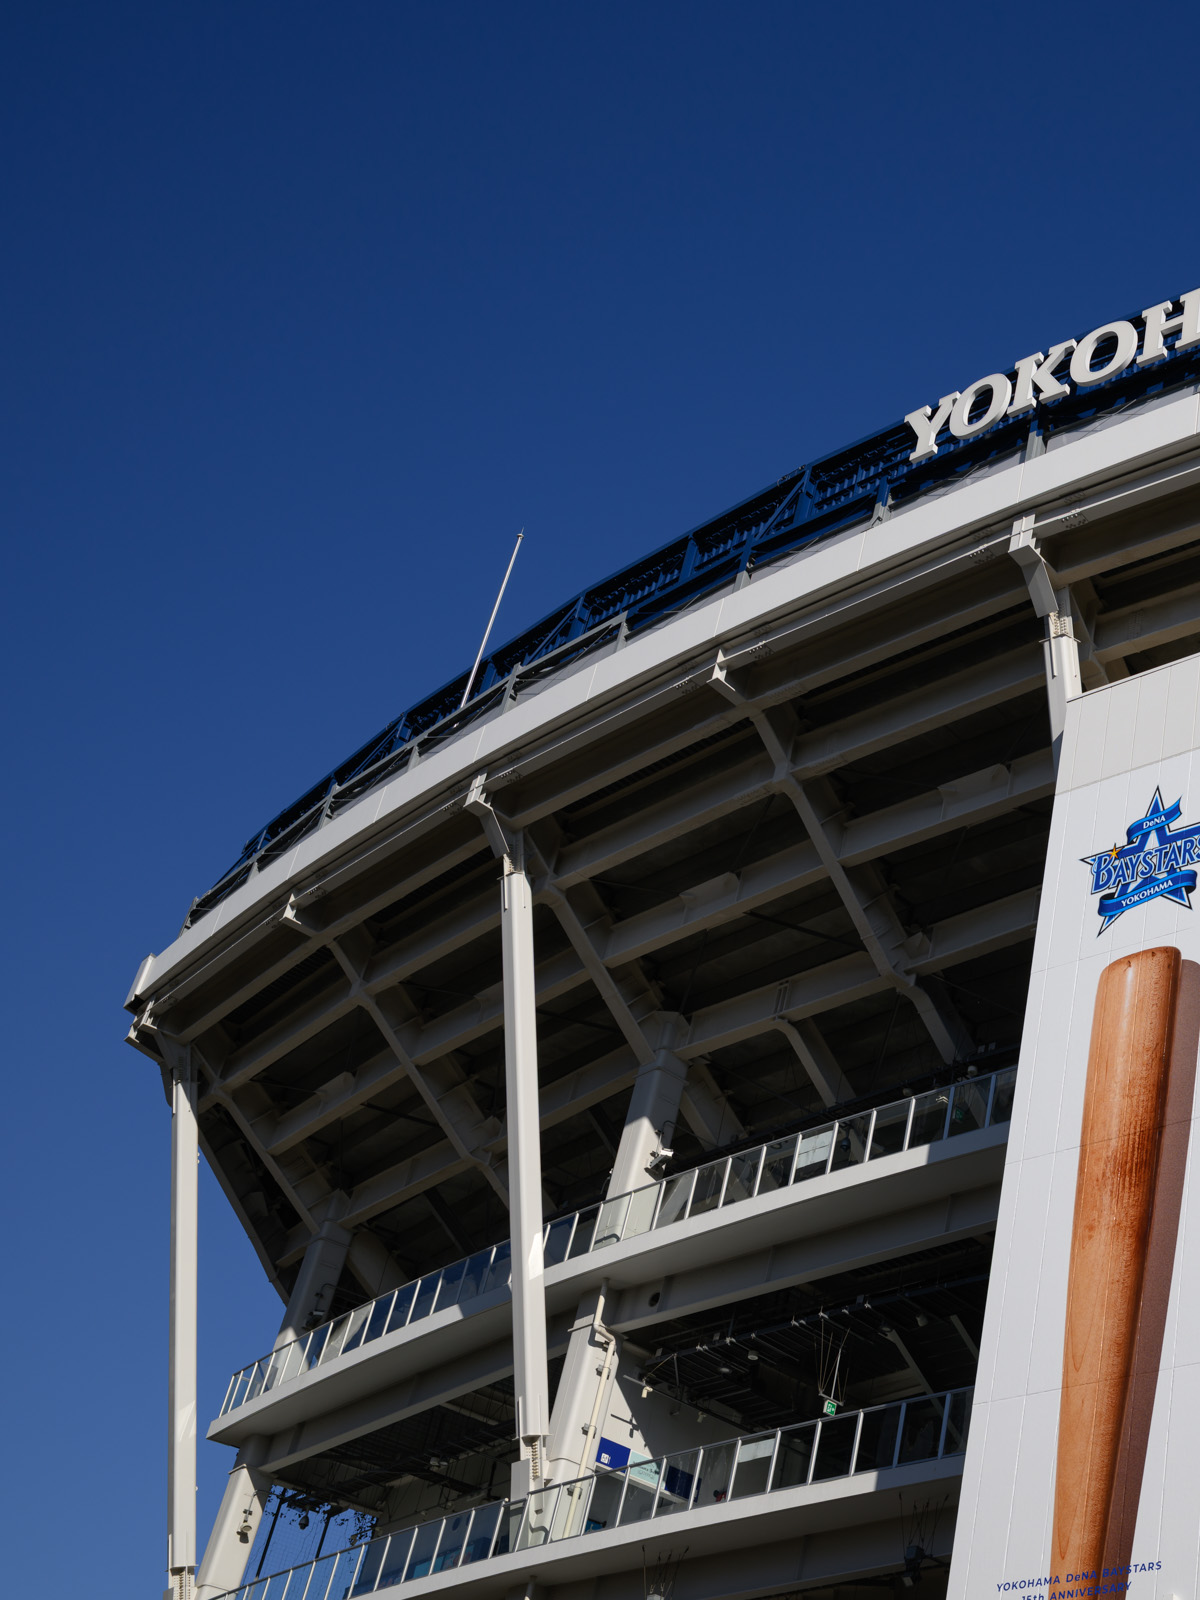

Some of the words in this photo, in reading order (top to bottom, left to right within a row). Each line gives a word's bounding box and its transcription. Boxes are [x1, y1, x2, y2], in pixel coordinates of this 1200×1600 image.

[1142, 814, 1166, 830] DeNA
[1121, 878, 1173, 907] YOKOHAMA
[996, 1575, 1061, 1592] YOKOHAMA
[1066, 1570, 1097, 1583] DeNA
[1102, 1560, 1163, 1578] BAYSTARS
[1050, 1581, 1132, 1600] ANNIVERSARY
